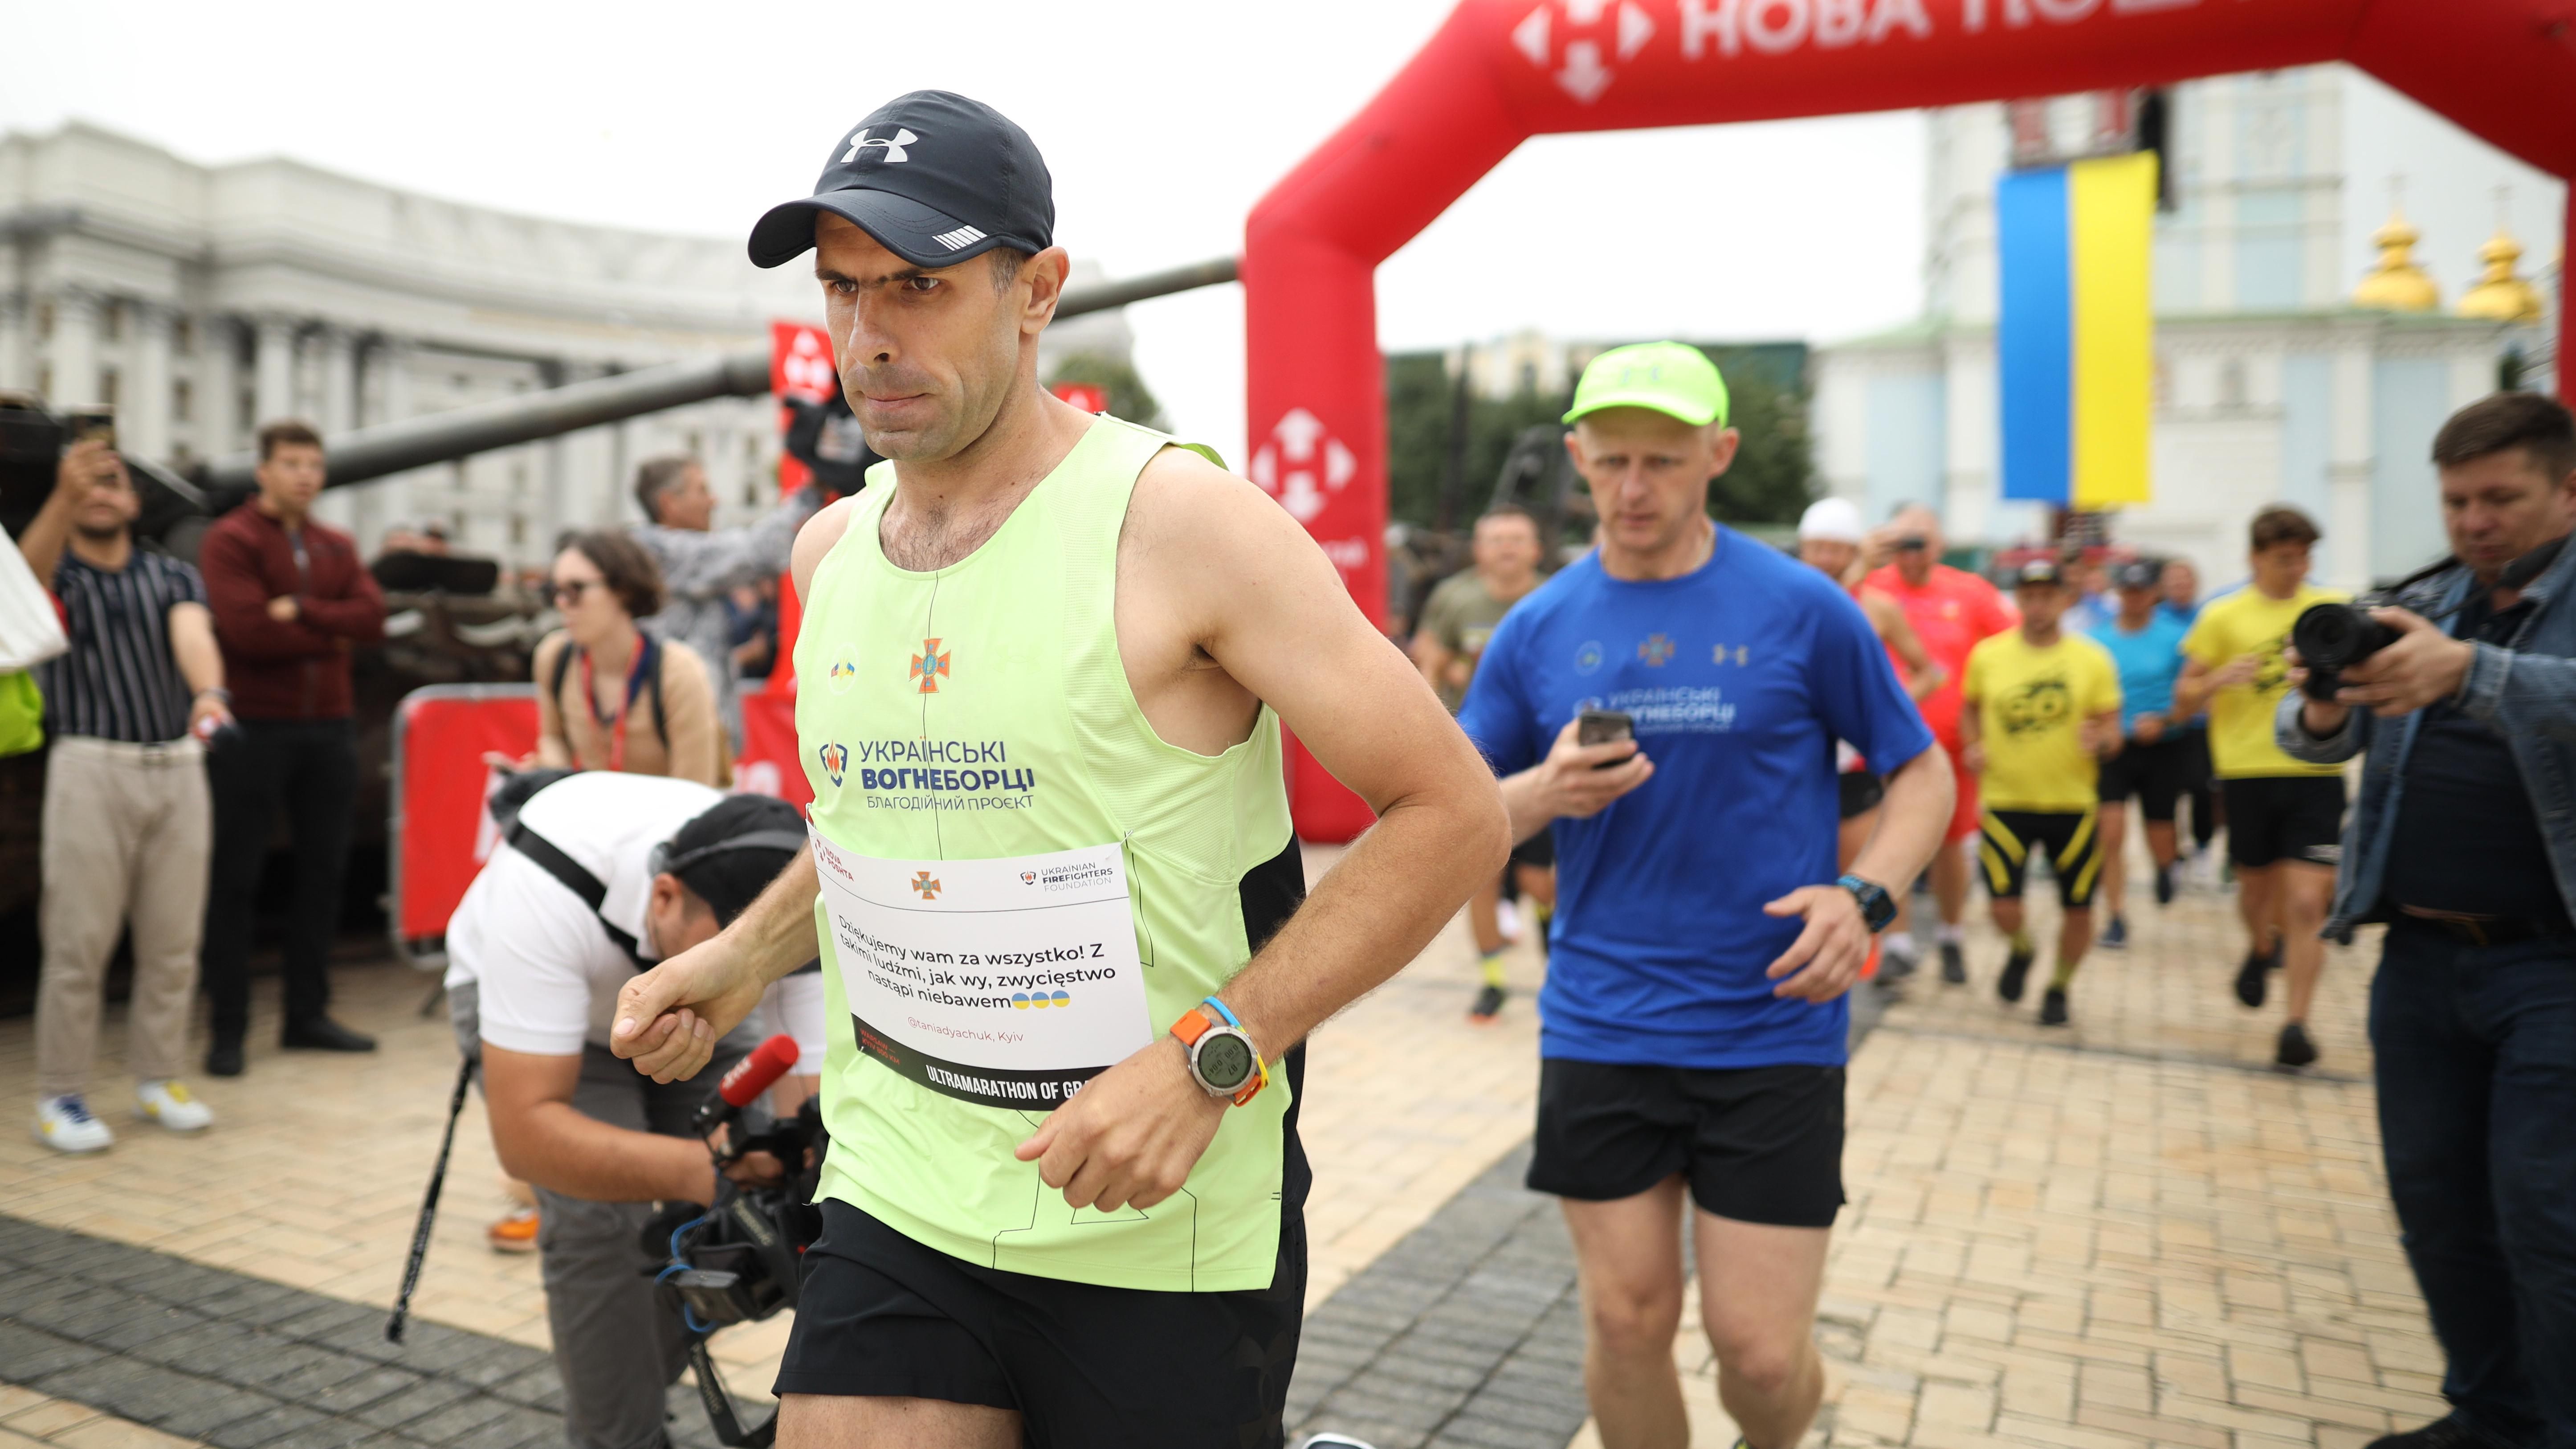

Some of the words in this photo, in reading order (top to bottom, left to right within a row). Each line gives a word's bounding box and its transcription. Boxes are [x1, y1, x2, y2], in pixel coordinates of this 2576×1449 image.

[1680, 0, 1933, 60] НОВА
[859, 735, 1006, 763] УКРАЇНСЬКІ
[861, 768, 1035, 792] ВОГНЕБОРЦІ
[867, 795, 964, 811] БЛАГОДІЙНИЙ
[968, 795, 1034, 811] ПРОЄКТ
[824, 846, 842, 866] NOVA
[827, 857, 854, 882] POSHTA
[1043, 868, 1113, 884] FIREFIGHTERS
[1044, 877, 1111, 892] FOUNDATION
[839, 914, 906, 960] Dziękujemy
[910, 950, 954, 964] wam
[959, 954, 980, 965] za
[985, 946, 1084, 967] wszystko!
[1090, 943, 1105, 958] Z
[840, 933, 872, 963] takimi
[873, 953, 926, 984] ludźmi,
[929, 969, 956, 985] jak
[959, 975, 992, 990] wy,
[997, 967, 1116, 989] zwycięstwo
[868, 970, 913, 998] nastąpi
[918, 988, 1011, 1008] niebawem
[861, 1029, 888, 1050] WARSAW
[908, 1016, 995, 1042] @taniadyachuk,
[998, 1032, 1023, 1044] Kyiv
[862, 1037, 876, 1050] KYIV
[925, 1064, 1038, 1100] ULTRAMARATHON
[1040, 1082, 1058, 1100] OF
